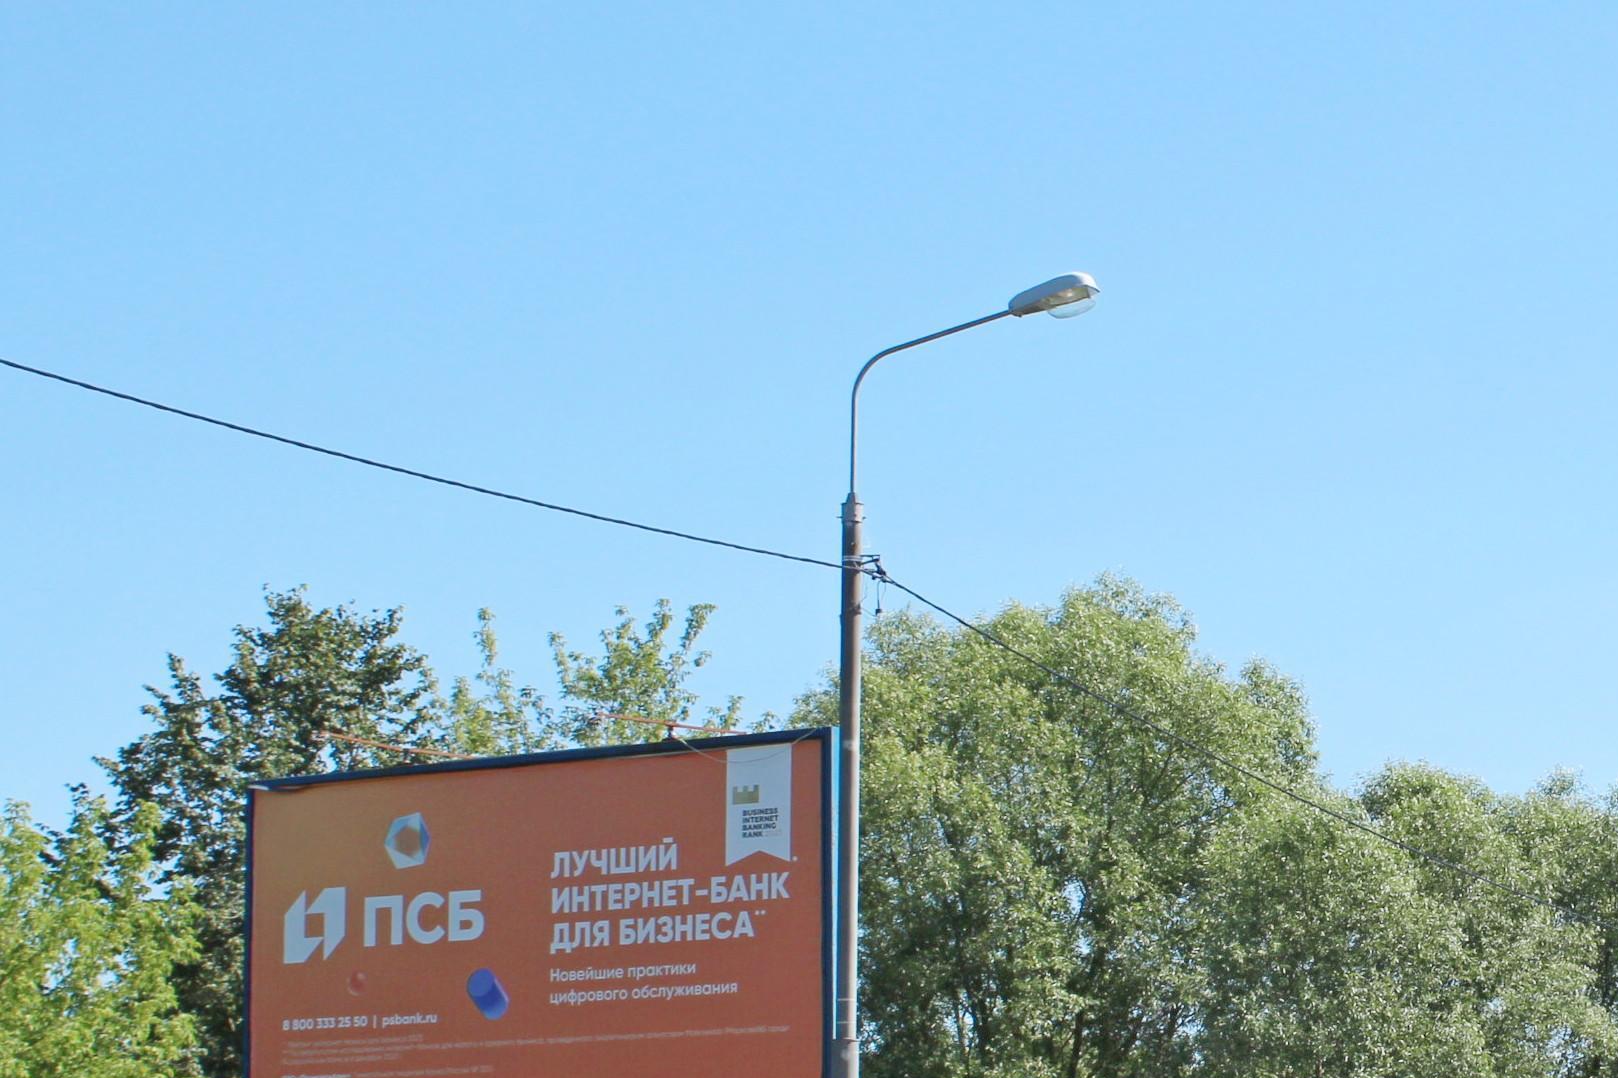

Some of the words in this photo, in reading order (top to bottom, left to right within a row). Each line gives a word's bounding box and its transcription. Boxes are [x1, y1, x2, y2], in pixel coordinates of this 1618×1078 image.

[742, 807, 778, 817] BUSINESS
[742, 815, 778, 823] INTERNET
[742, 822, 777, 831] BANKING
[550, 837, 678, 879] ЛУЧШИЙ
[551, 871, 790, 914] ИНТЕРНЕТ-БАНК
[363, 889, 485, 947] ПСБ
[550, 920, 610, 954] ДЛЯ
[549, 967, 624, 982] Новейшие
[627, 962, 697, 980] практики
[549, 988, 628, 1005] цифрового
[631, 982, 738, 1001] обслуживания
[282, 1020, 289, 1031] 8
[292, 1019, 314, 1031] 800
[316, 1017, 336, 1029] 333
[338, 1016, 351, 1028] 25
[353, 1016, 368, 1027] 50
[381, 1012, 438, 1028] psbank.ru
